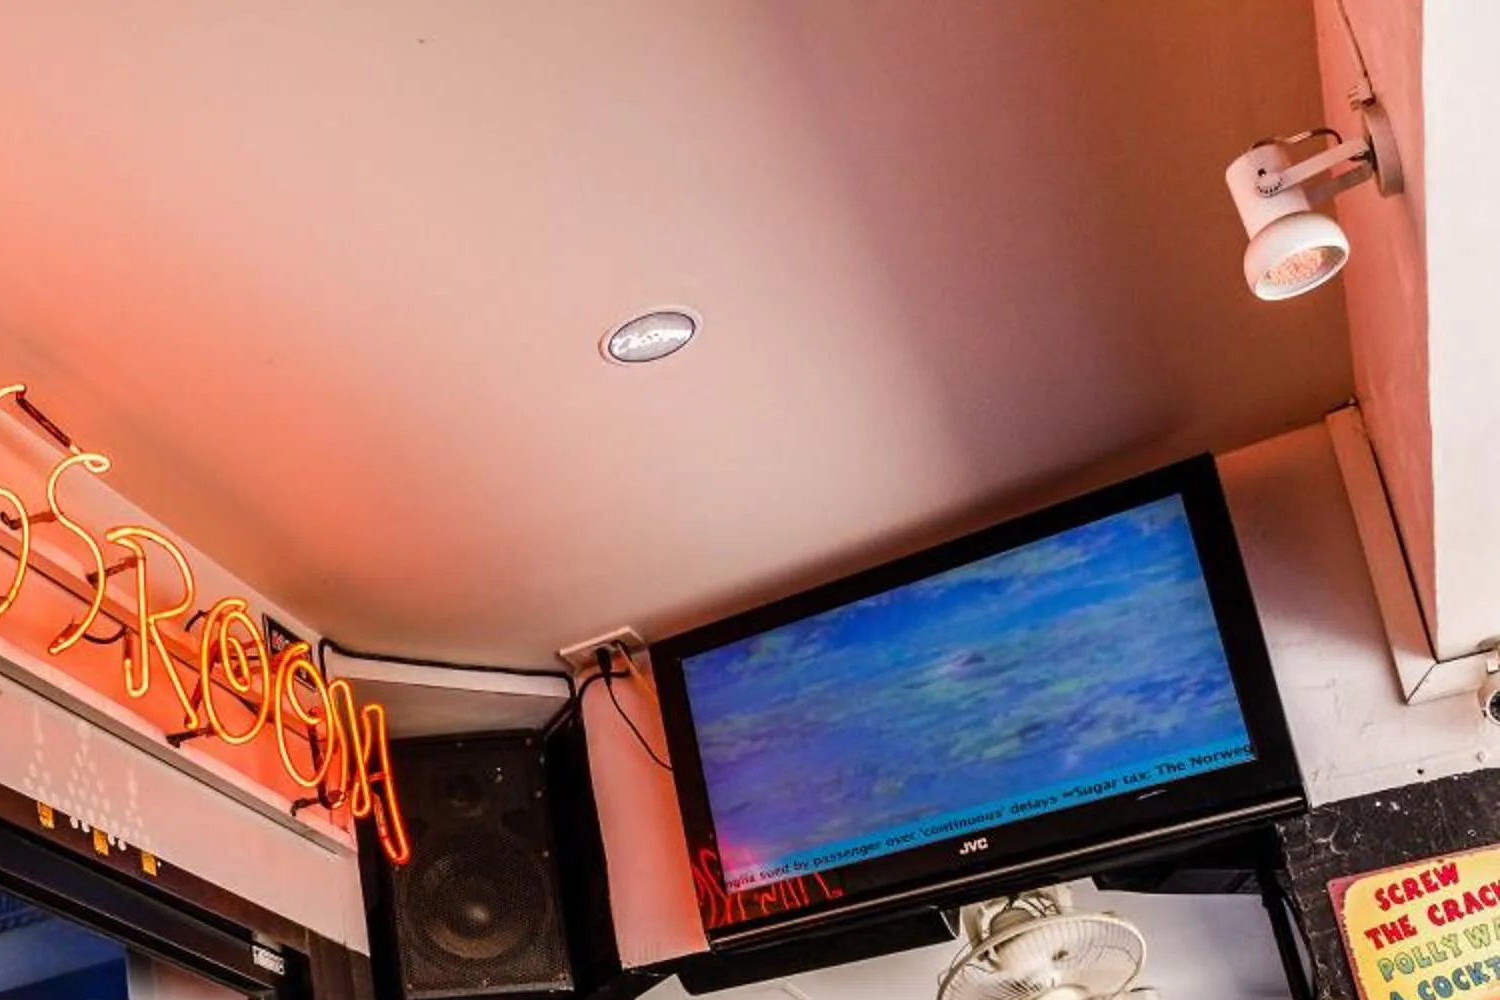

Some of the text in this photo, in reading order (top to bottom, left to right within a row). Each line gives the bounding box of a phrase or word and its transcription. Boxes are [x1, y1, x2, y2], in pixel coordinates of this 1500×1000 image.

[793, 859, 809, 873] by
[813, 841, 881, 868] passenger
[885, 831, 917, 848] over
[1010, 795, 1057, 815] delays
[1156, 759, 1186, 777] The
[959, 837, 989, 855] JVC
[1374, 862, 1460, 912] SCREW
[1364, 914, 1419, 951] THE
[1377, 933, 1463, 983] POLLY
